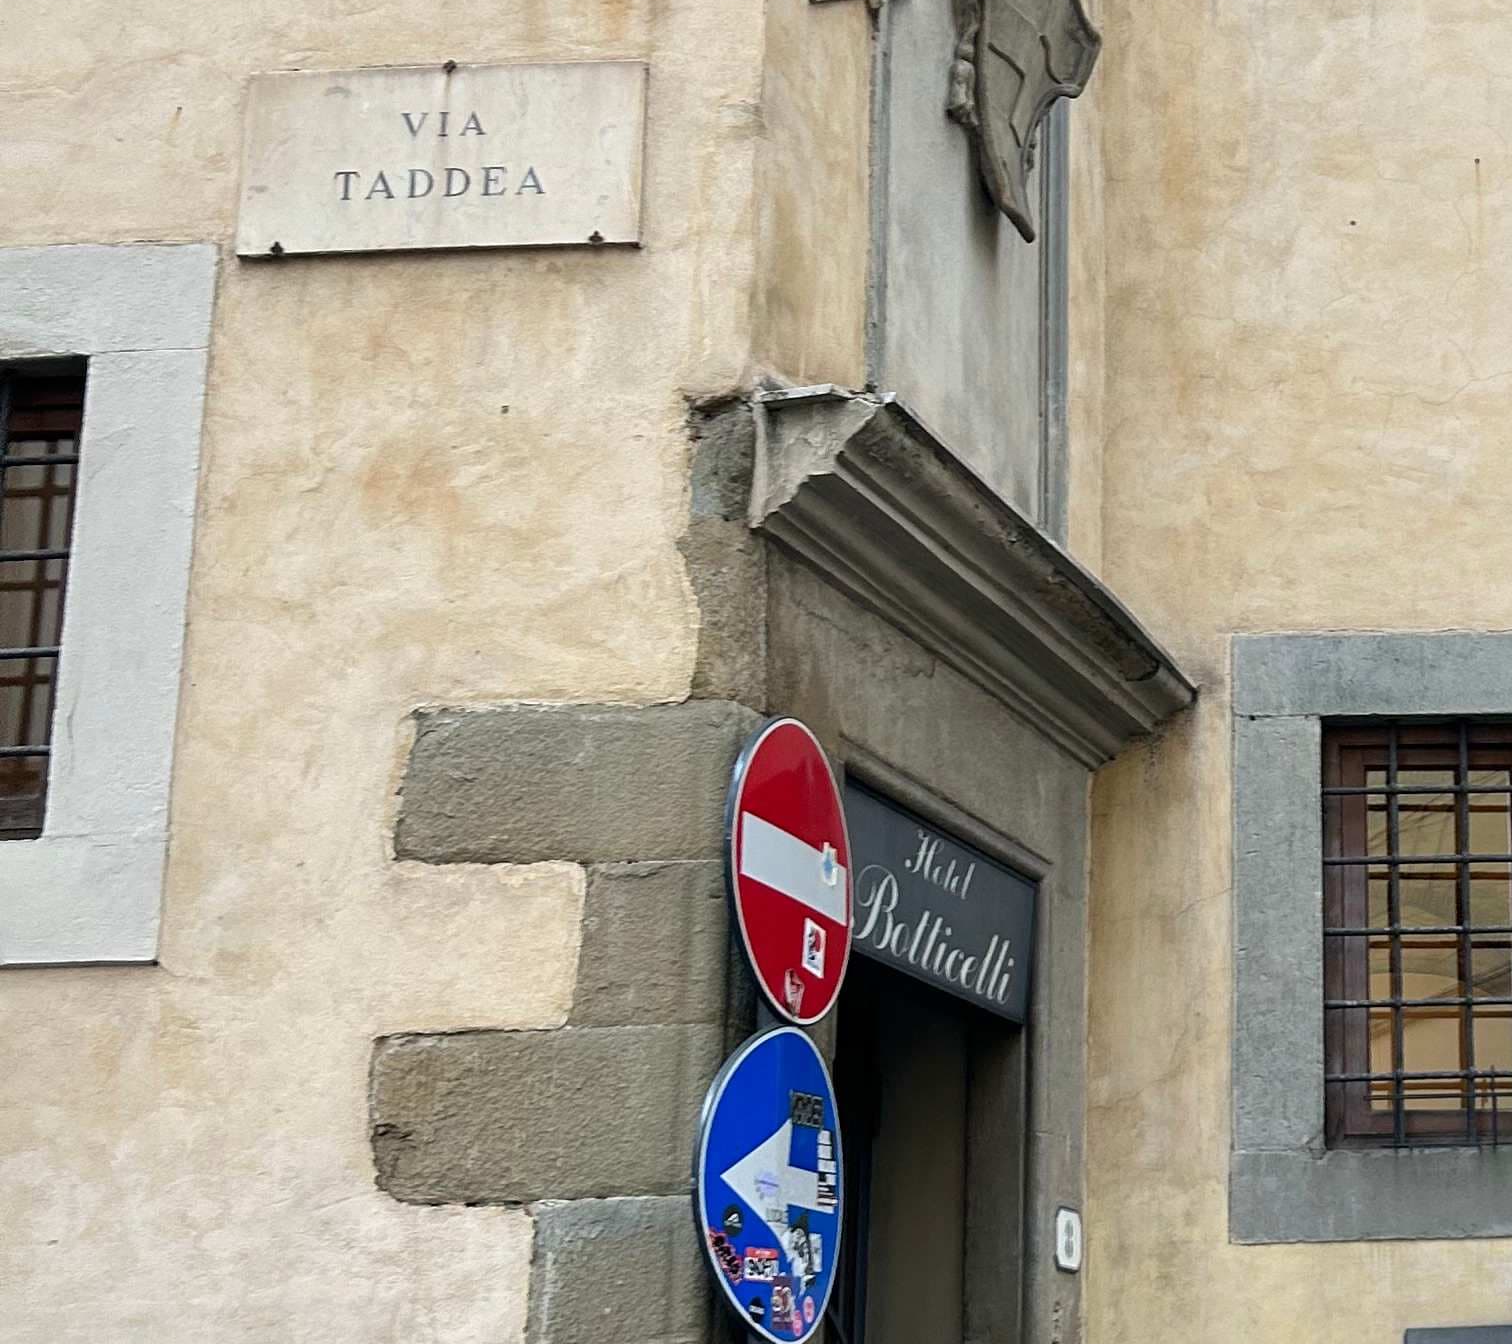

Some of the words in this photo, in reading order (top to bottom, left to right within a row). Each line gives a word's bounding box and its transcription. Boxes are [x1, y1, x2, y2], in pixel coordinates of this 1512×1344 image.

[401, 111, 487, 138] VIA
[333, 166, 547, 201] TADDEA
[904, 828, 976, 900] Hotel
[851, 863, 1015, 1006] Botticelli
